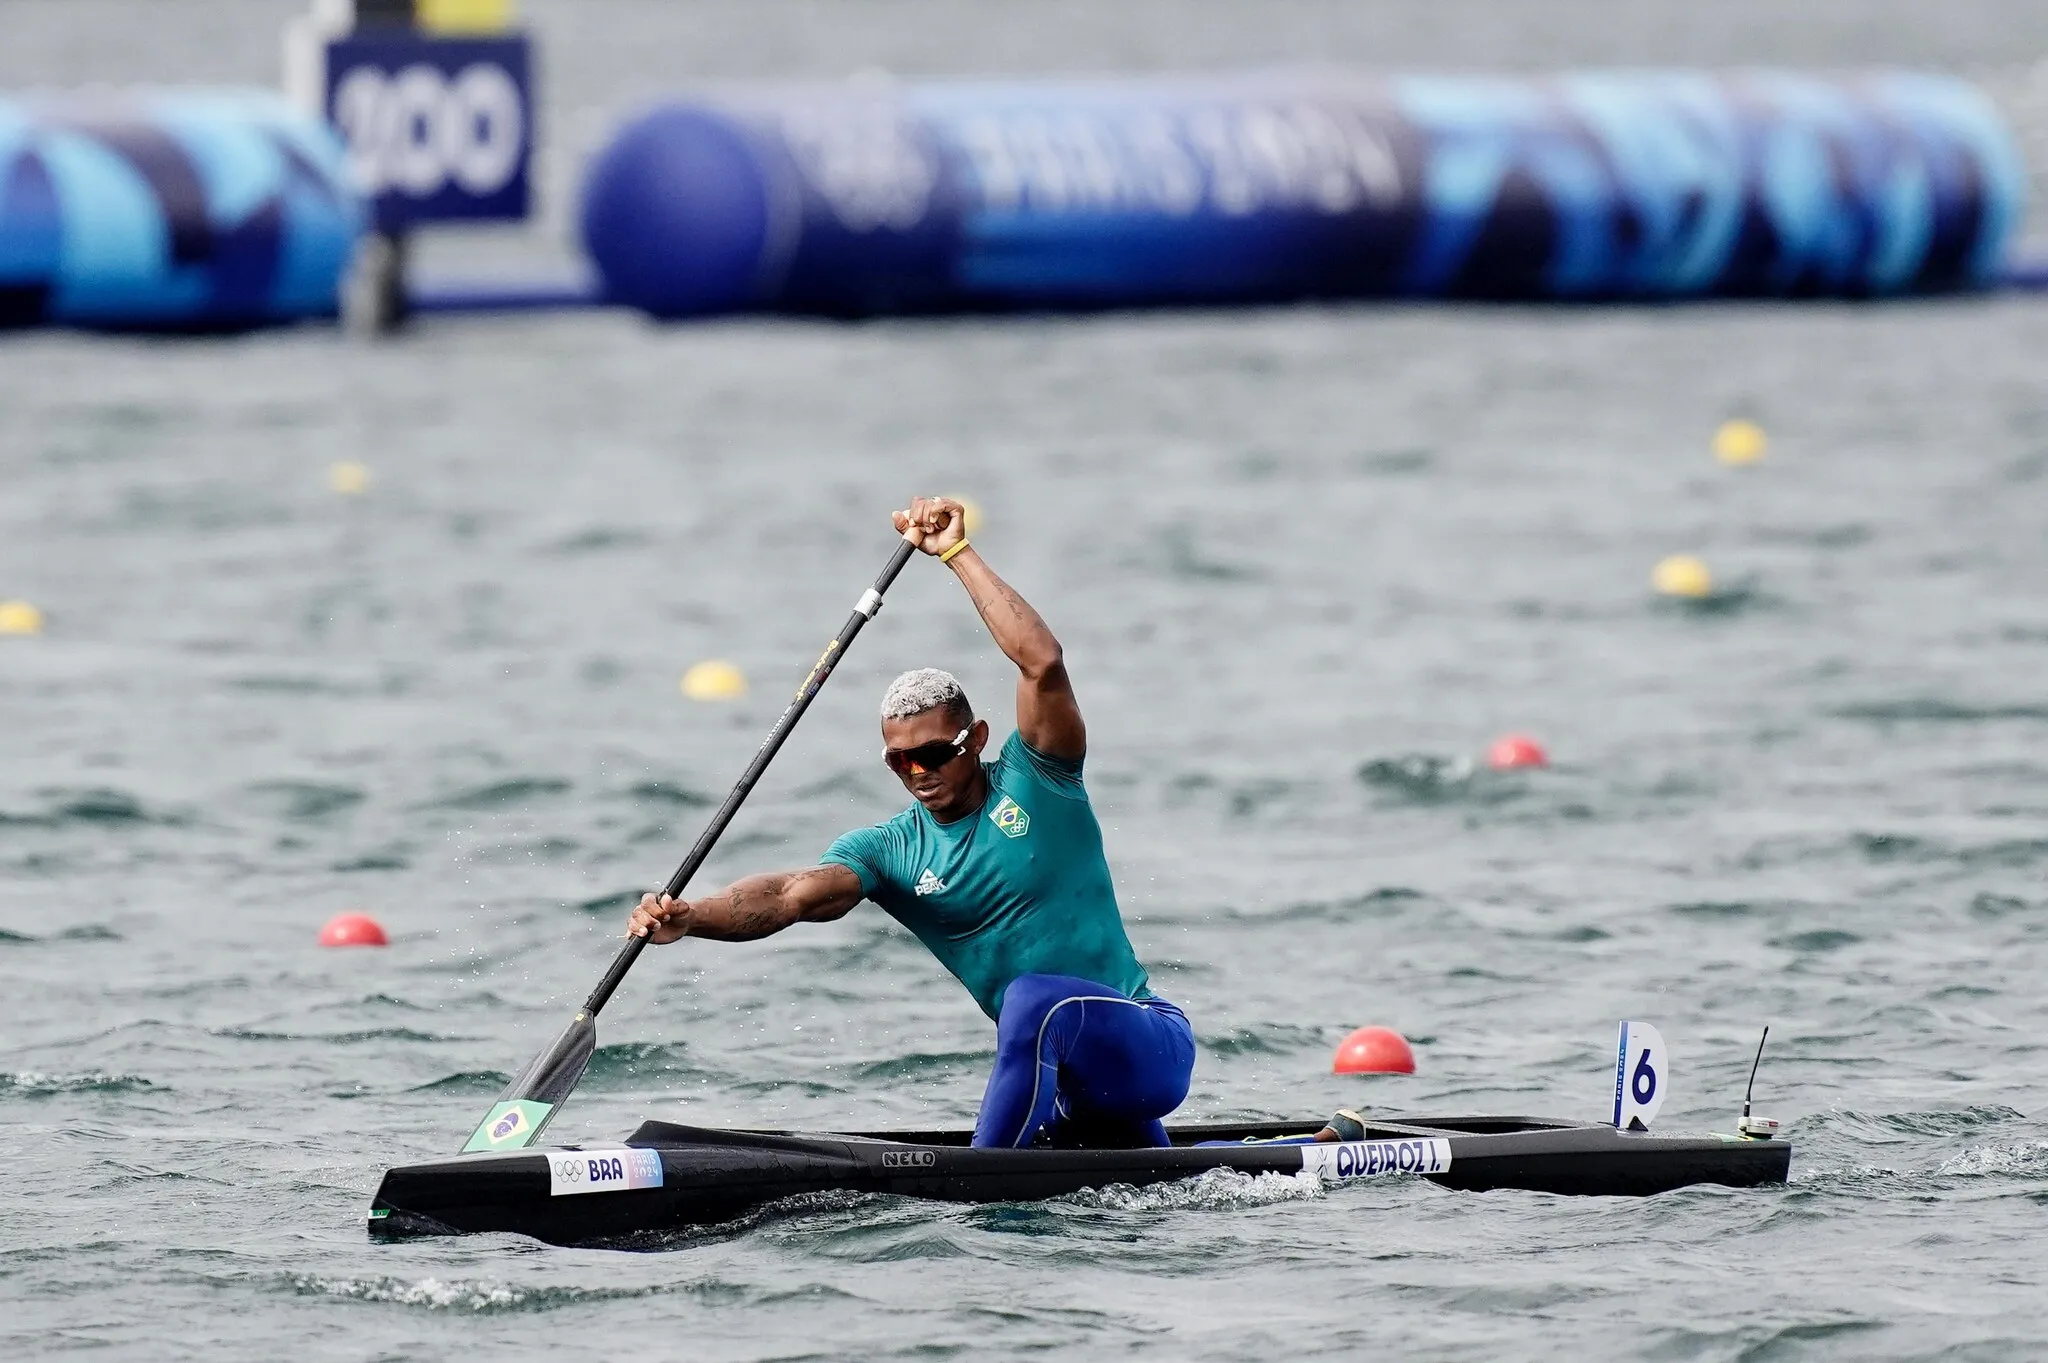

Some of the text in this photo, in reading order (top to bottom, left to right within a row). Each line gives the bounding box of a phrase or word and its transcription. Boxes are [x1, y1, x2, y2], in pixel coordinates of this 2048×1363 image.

[336, 64, 521, 197] 200
[914, 877, 948, 897] PEAK
[1632, 1048, 1656, 1105] 6
[587, 1157, 623, 1182] BRA
[630, 1154, 656, 1165] PARIS
[883, 1152, 934, 1166] NELO
[1336, 1140, 1441, 1177] QUEIROZ I.
[634, 1166, 658, 1178] 2024
